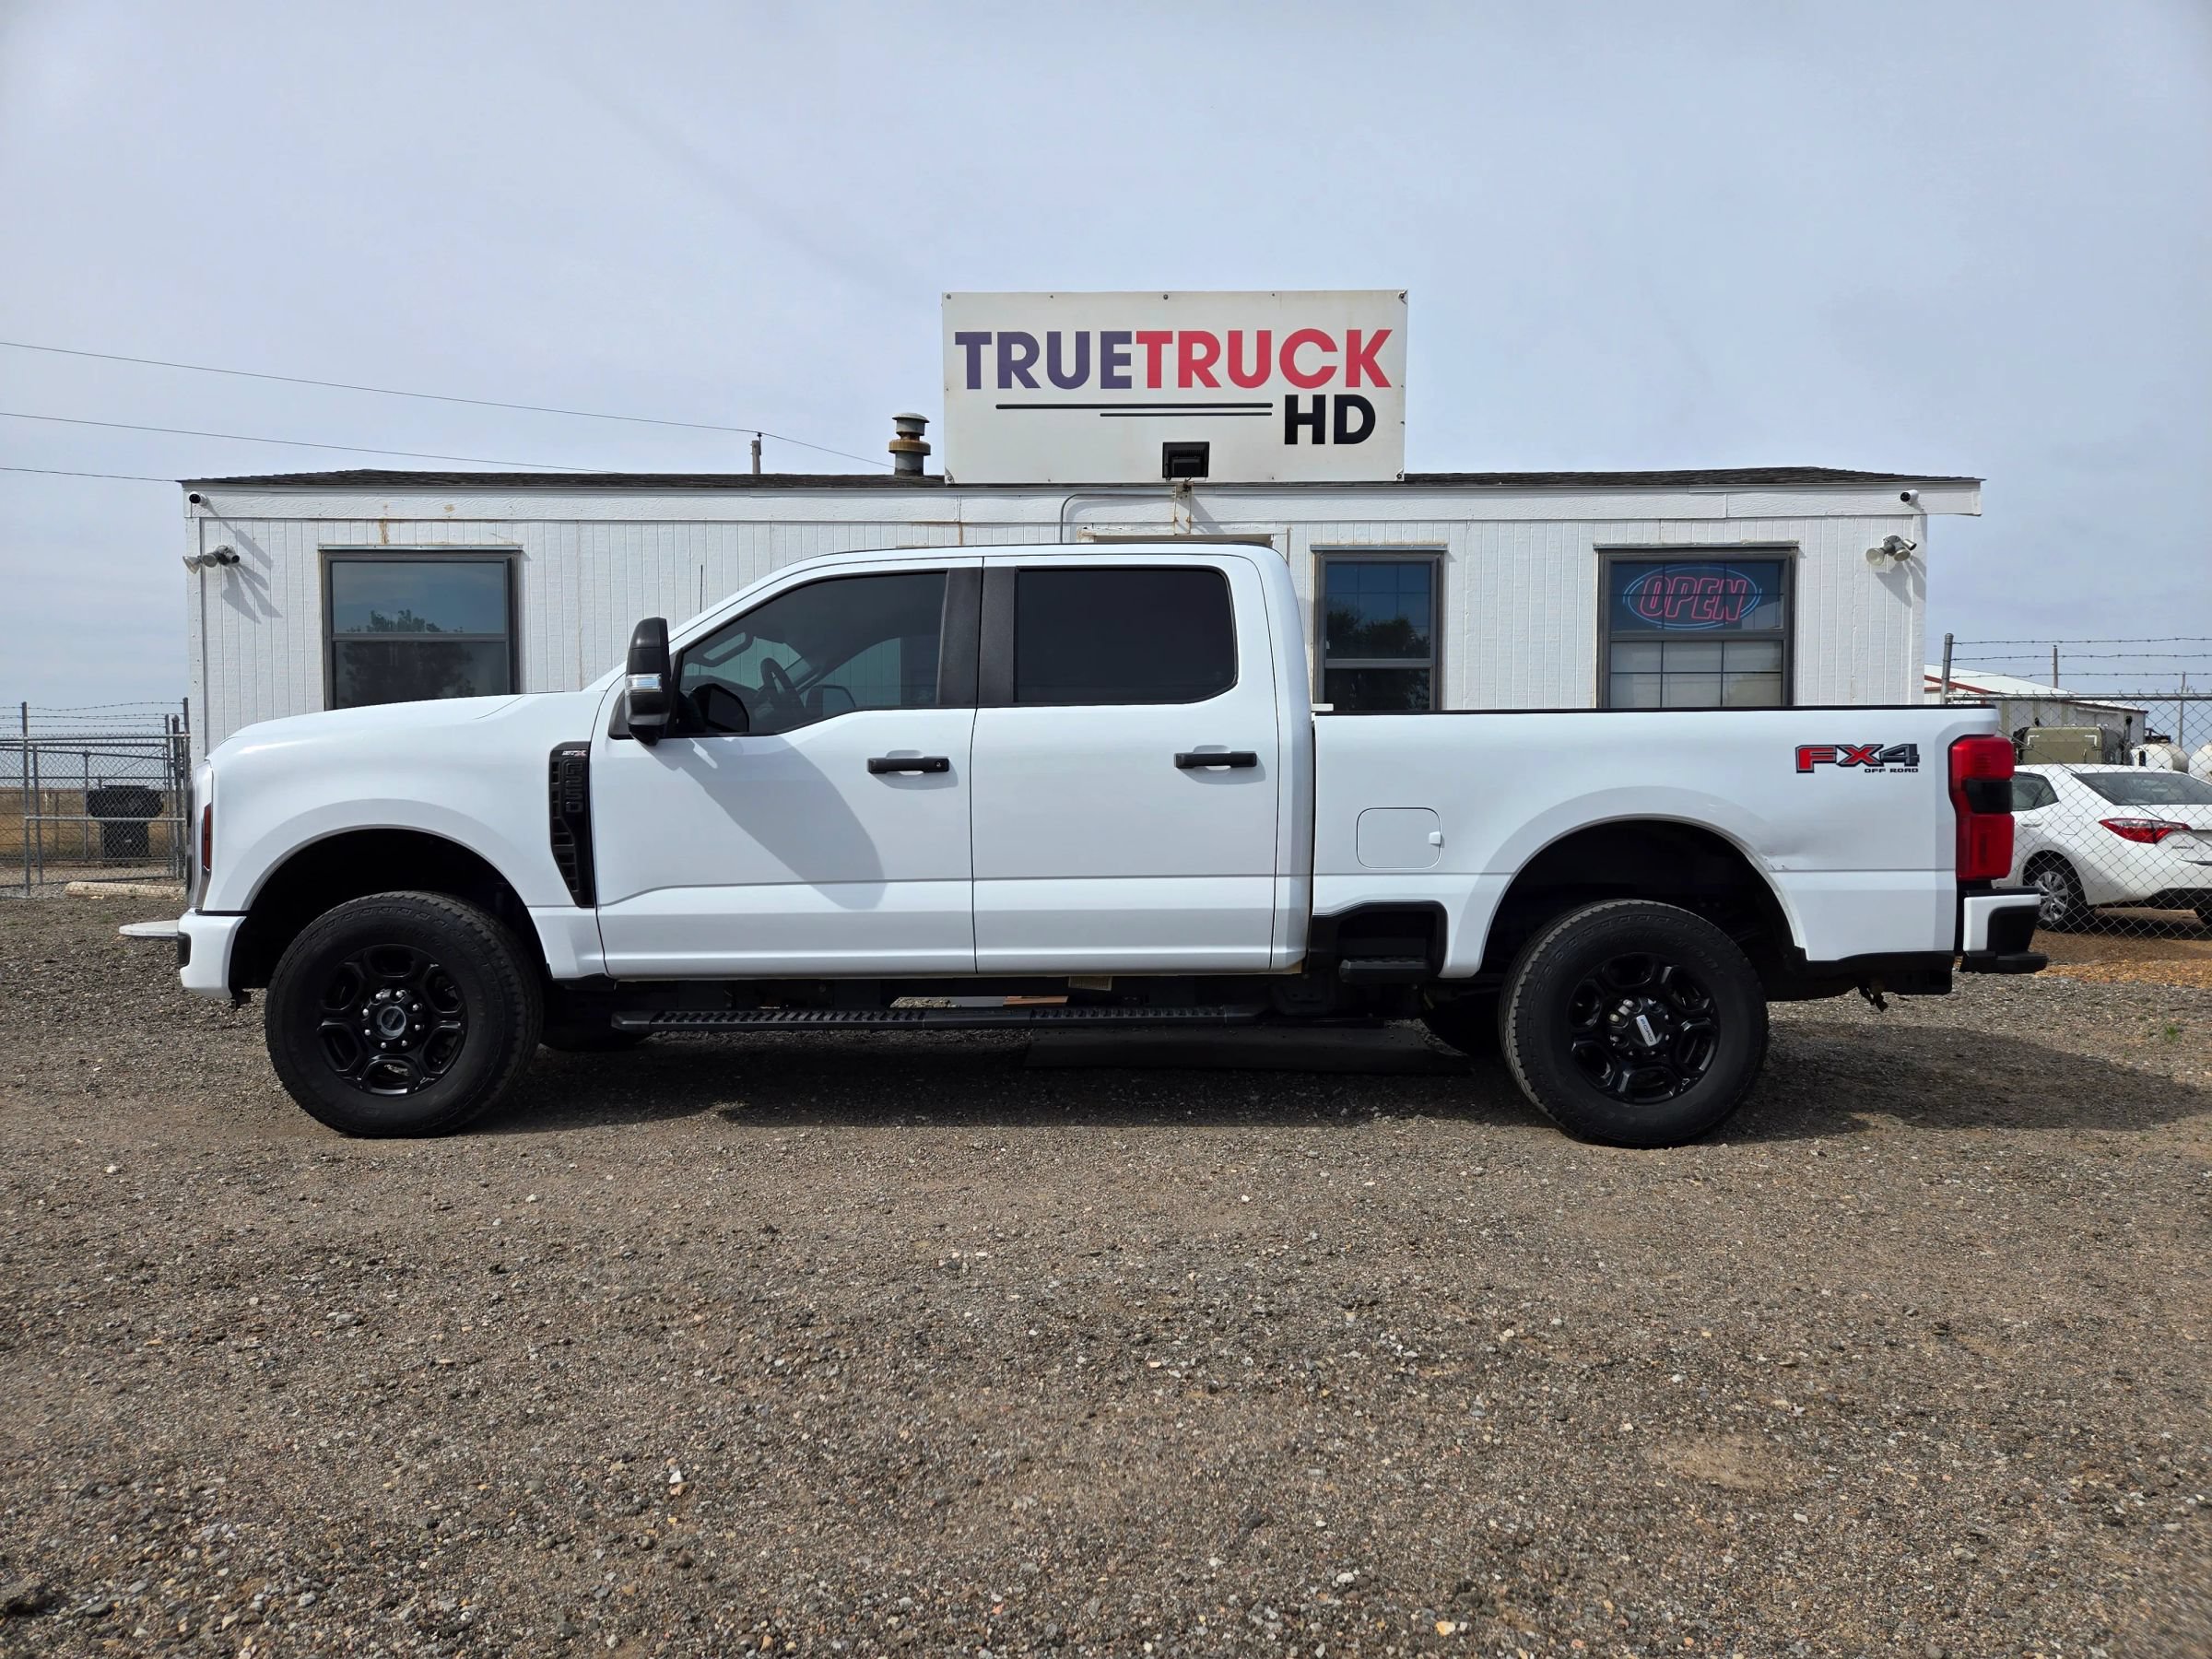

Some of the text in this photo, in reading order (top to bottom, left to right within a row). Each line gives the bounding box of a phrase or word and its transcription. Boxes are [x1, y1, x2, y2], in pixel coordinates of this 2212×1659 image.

[955, 328, 1393, 389] TRUETRUCK
[1284, 394, 1376, 445] HD
[1640, 575, 1747, 621] OPEN
[1795, 743, 1920, 773] FX4
